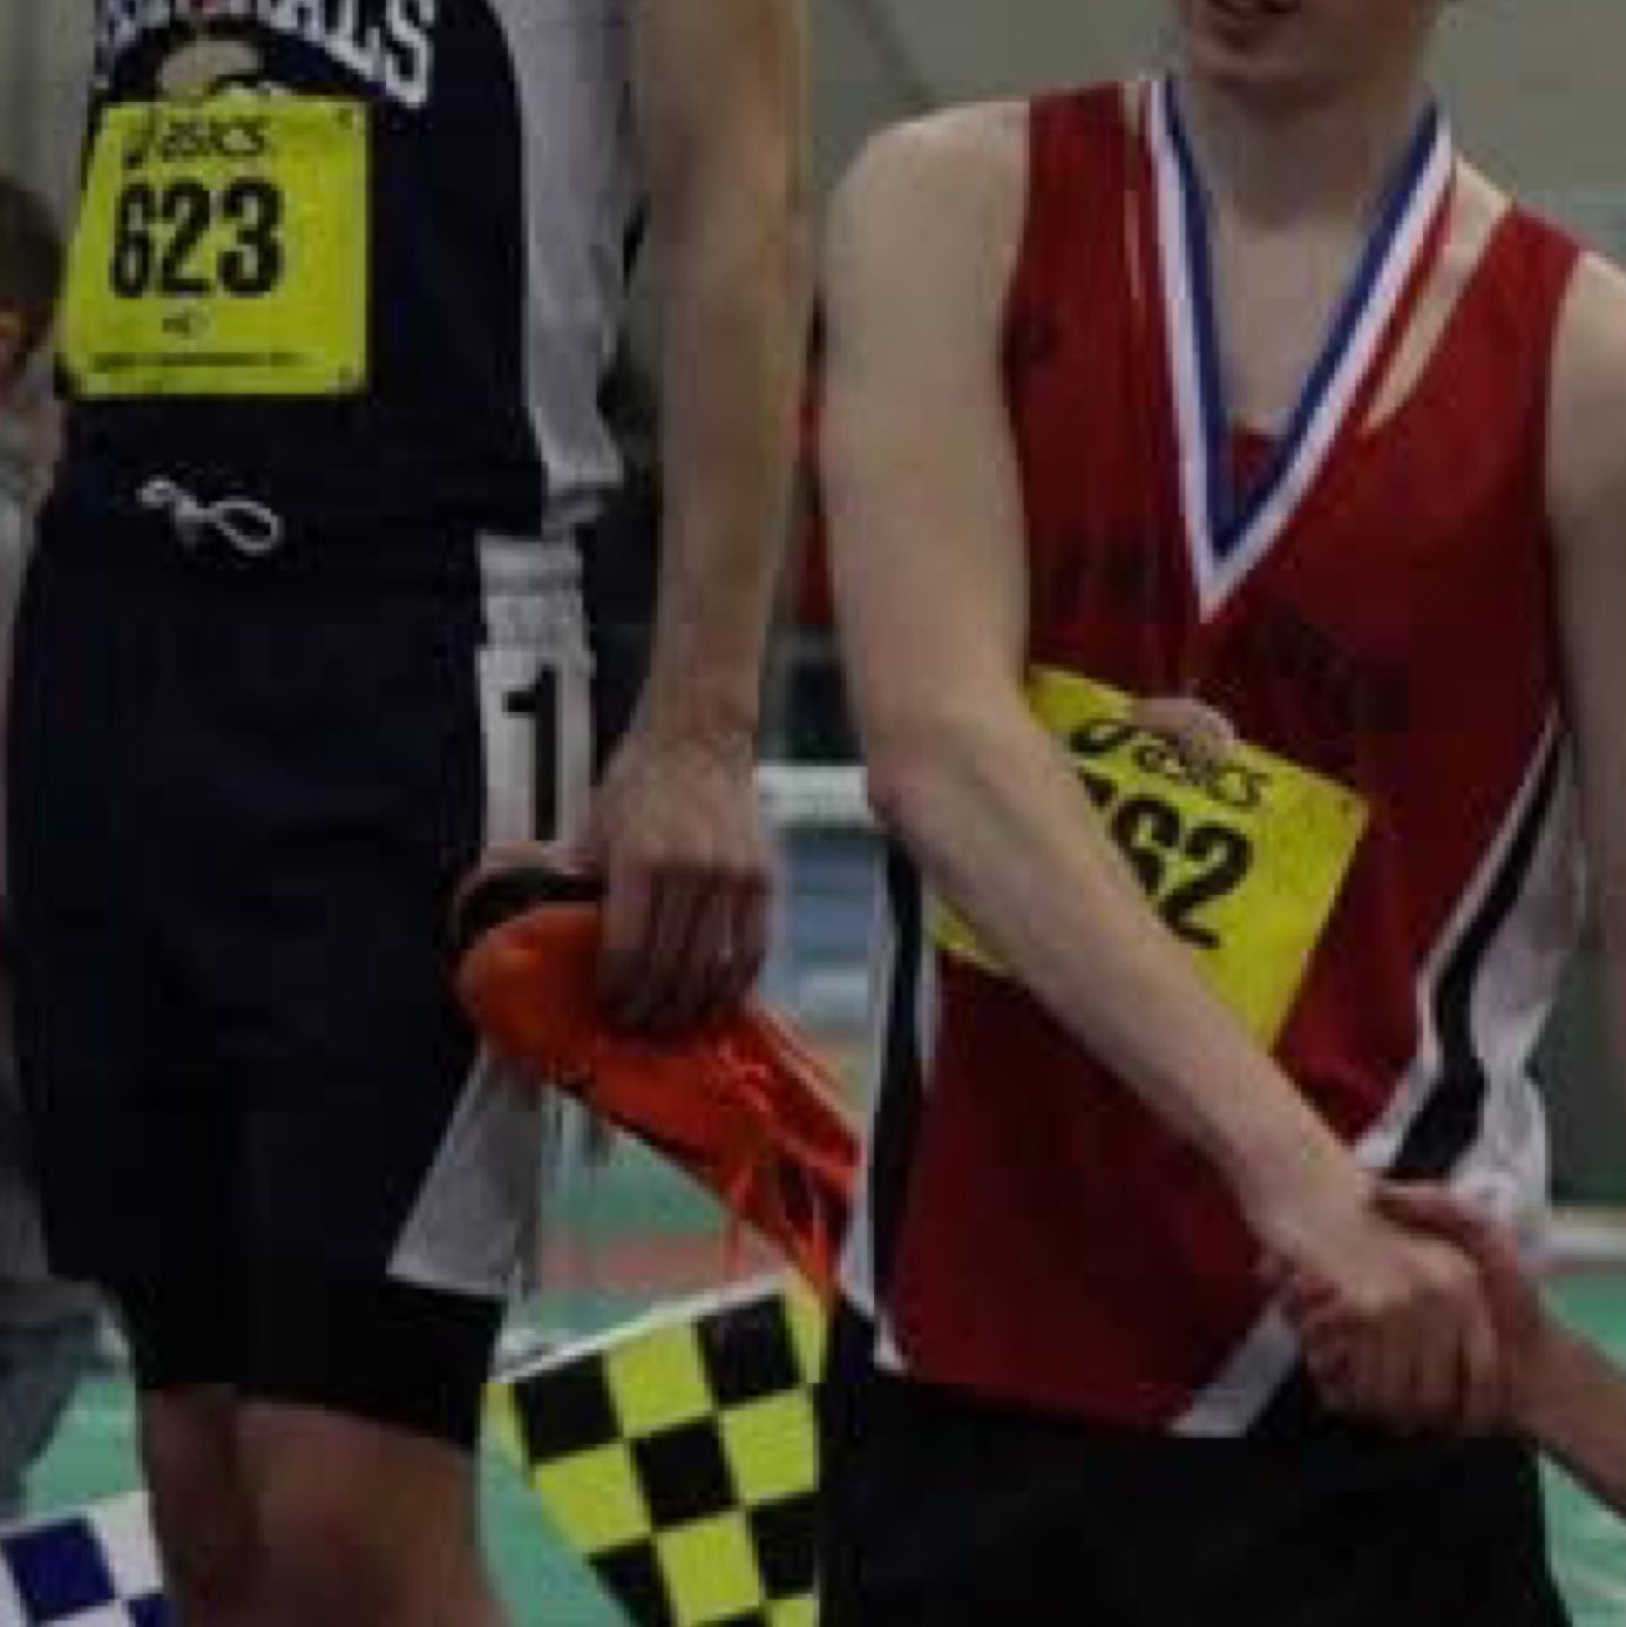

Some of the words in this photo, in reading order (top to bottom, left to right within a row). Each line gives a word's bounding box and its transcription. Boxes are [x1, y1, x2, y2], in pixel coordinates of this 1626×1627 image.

[111, 179, 284, 298] 623
[503, 661, 559, 842] 1
[1079, 767, 1255, 950] 62
